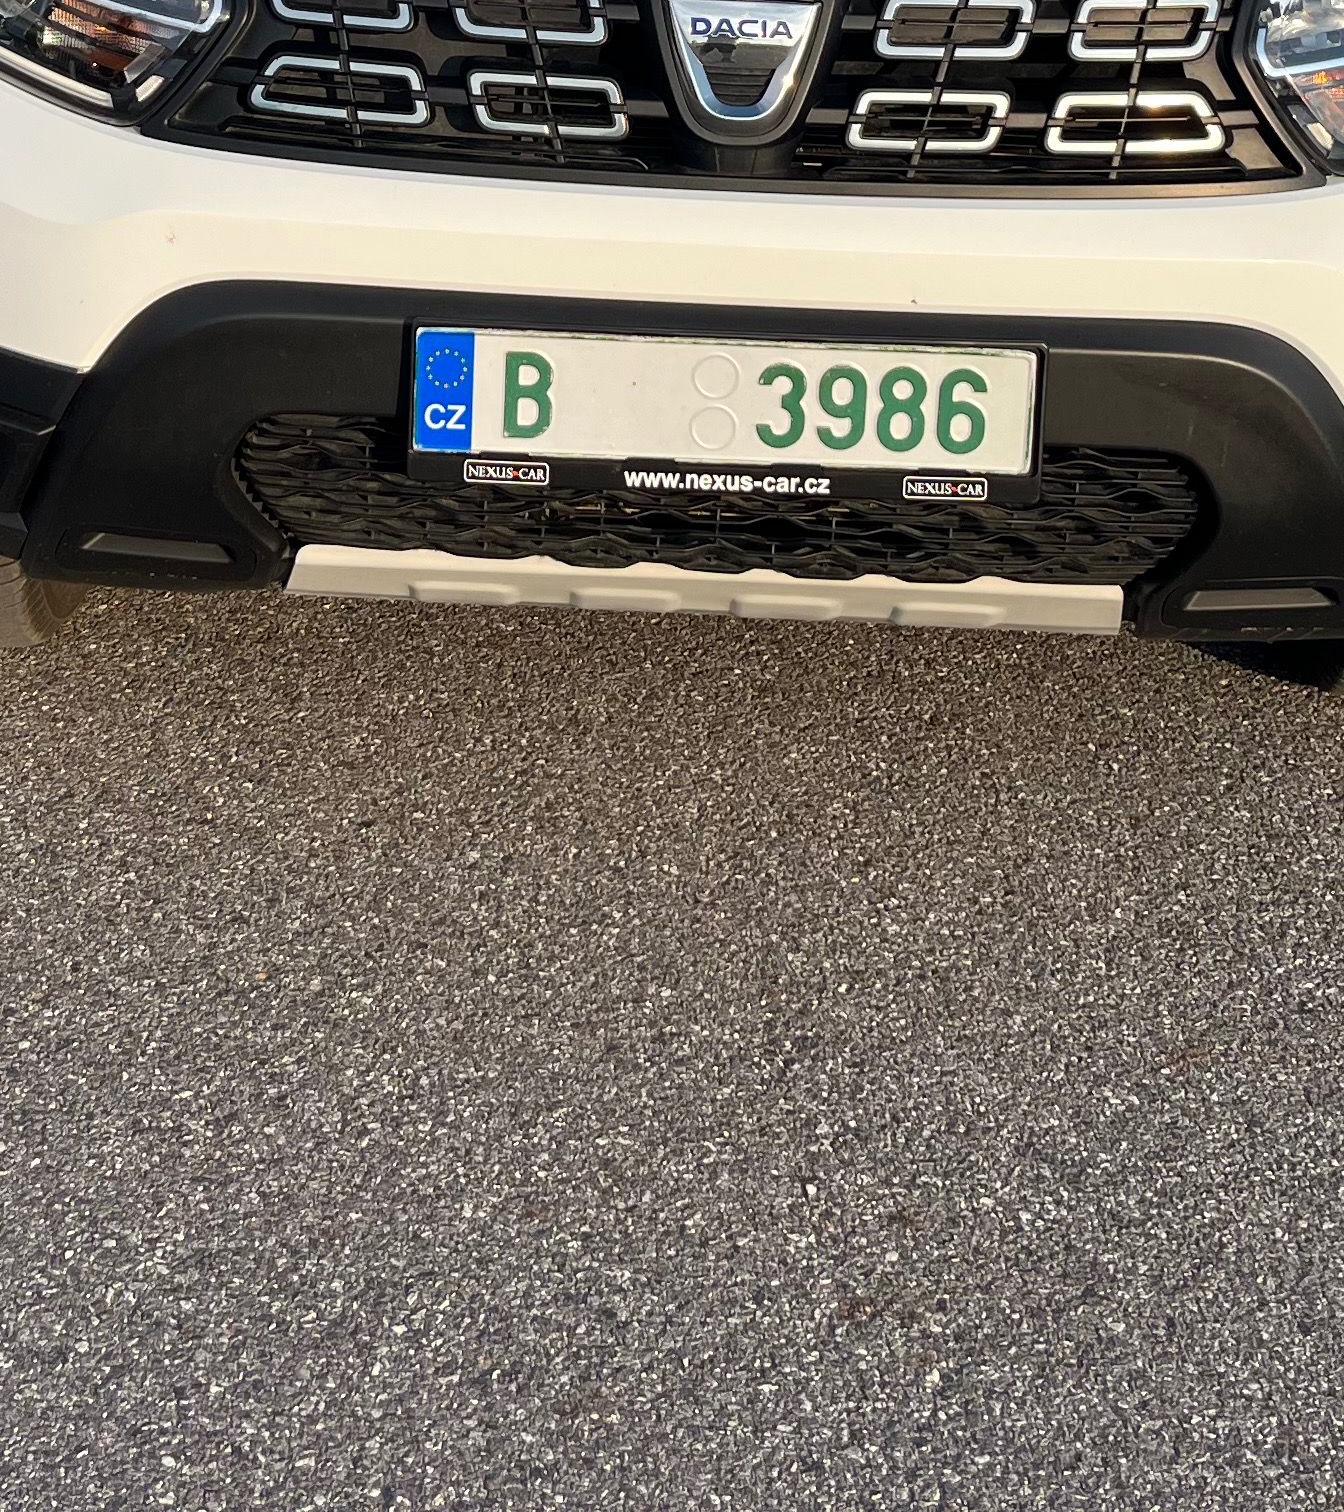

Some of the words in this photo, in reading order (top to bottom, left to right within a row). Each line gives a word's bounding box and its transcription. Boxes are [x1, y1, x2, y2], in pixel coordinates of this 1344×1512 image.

[690, 16, 793, 39] DACIA
[503, 352, 552, 438] B
[756, 364, 988, 454] 3986
[424, 403, 466, 430] CZ
[624, 470, 830, 494] www.nexus-car.cz
